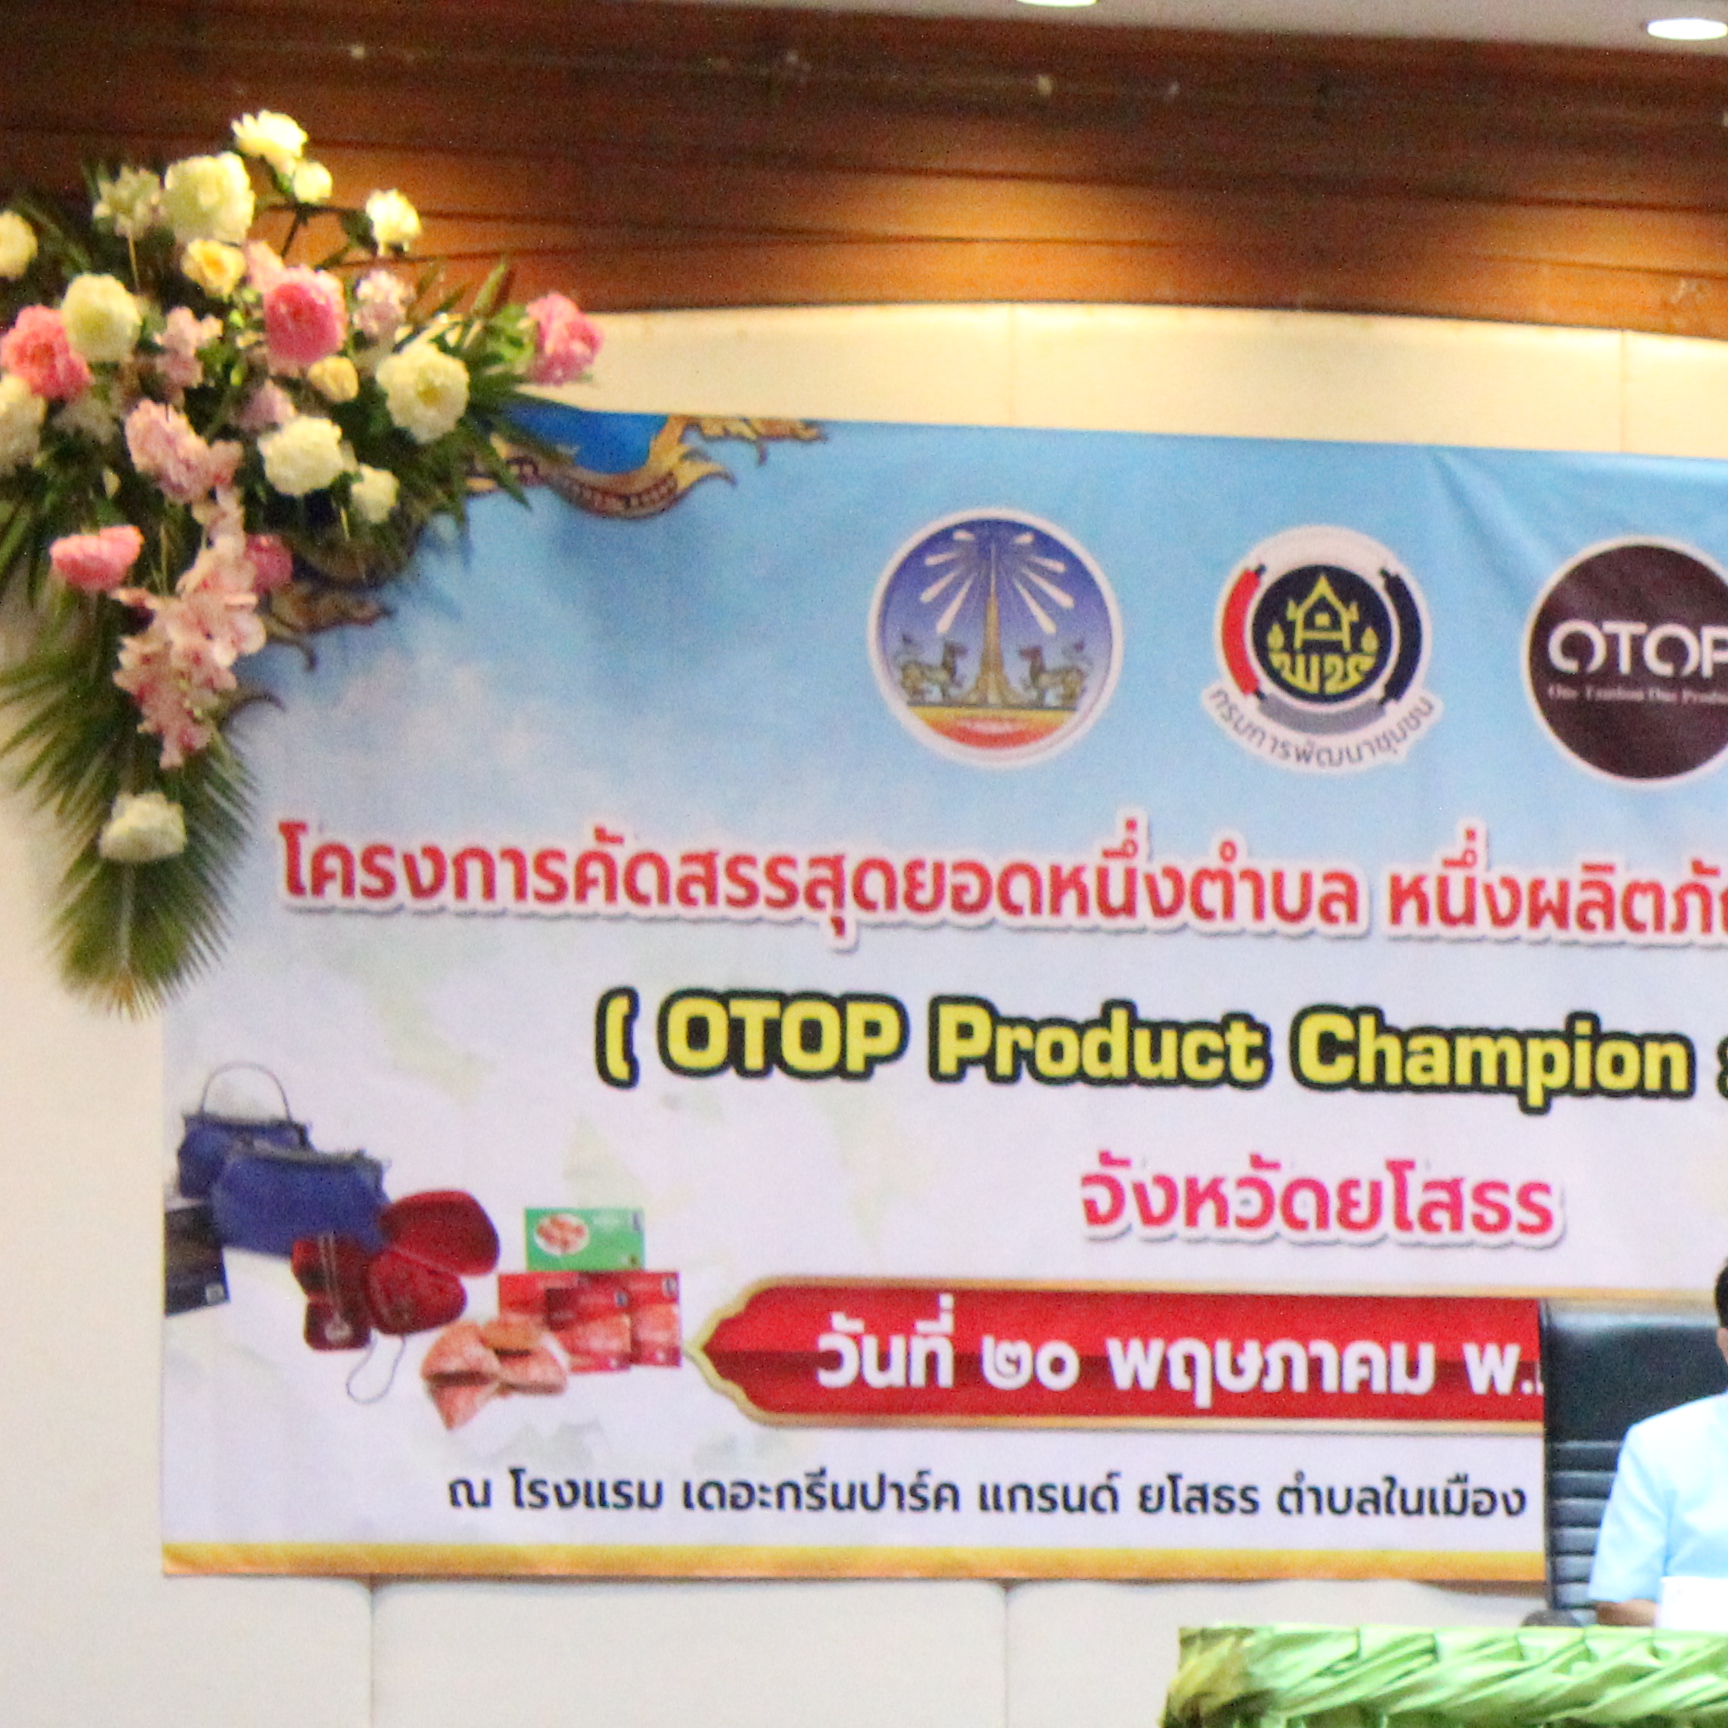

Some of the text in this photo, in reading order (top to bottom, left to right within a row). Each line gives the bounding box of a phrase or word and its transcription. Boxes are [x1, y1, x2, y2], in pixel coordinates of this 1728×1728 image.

[1209, 688, 1434, 767] กรมการพัฒนาชุมชน
[281, 819, 1359, 936] โครงการคัดสรรสุดยอดหนึ่งตำบล
[662, 992, 906, 1080] OTOP
[934, 999, 1267, 1085] Product
[1294, 1008, 1692, 1111] Champion
[1081, 1150, 1554, 1236] จังหวัดยโสธร
[815, 1291, 1545, 1408] วันที่ ๒๐ พฤษภาคม พ.
[448, 1477, 492, 1510] ณ
[508, 1466, 664, 1511] โรงแรม
[682, 1466, 962, 1512] เดอะกรีนปาร์ค
[977, 1471, 1122, 1515] แกรนด์
[1138, 1472, 1261, 1516] ยโสธร
[1276, 1471, 1527, 1517] ตำบลในเมือง
